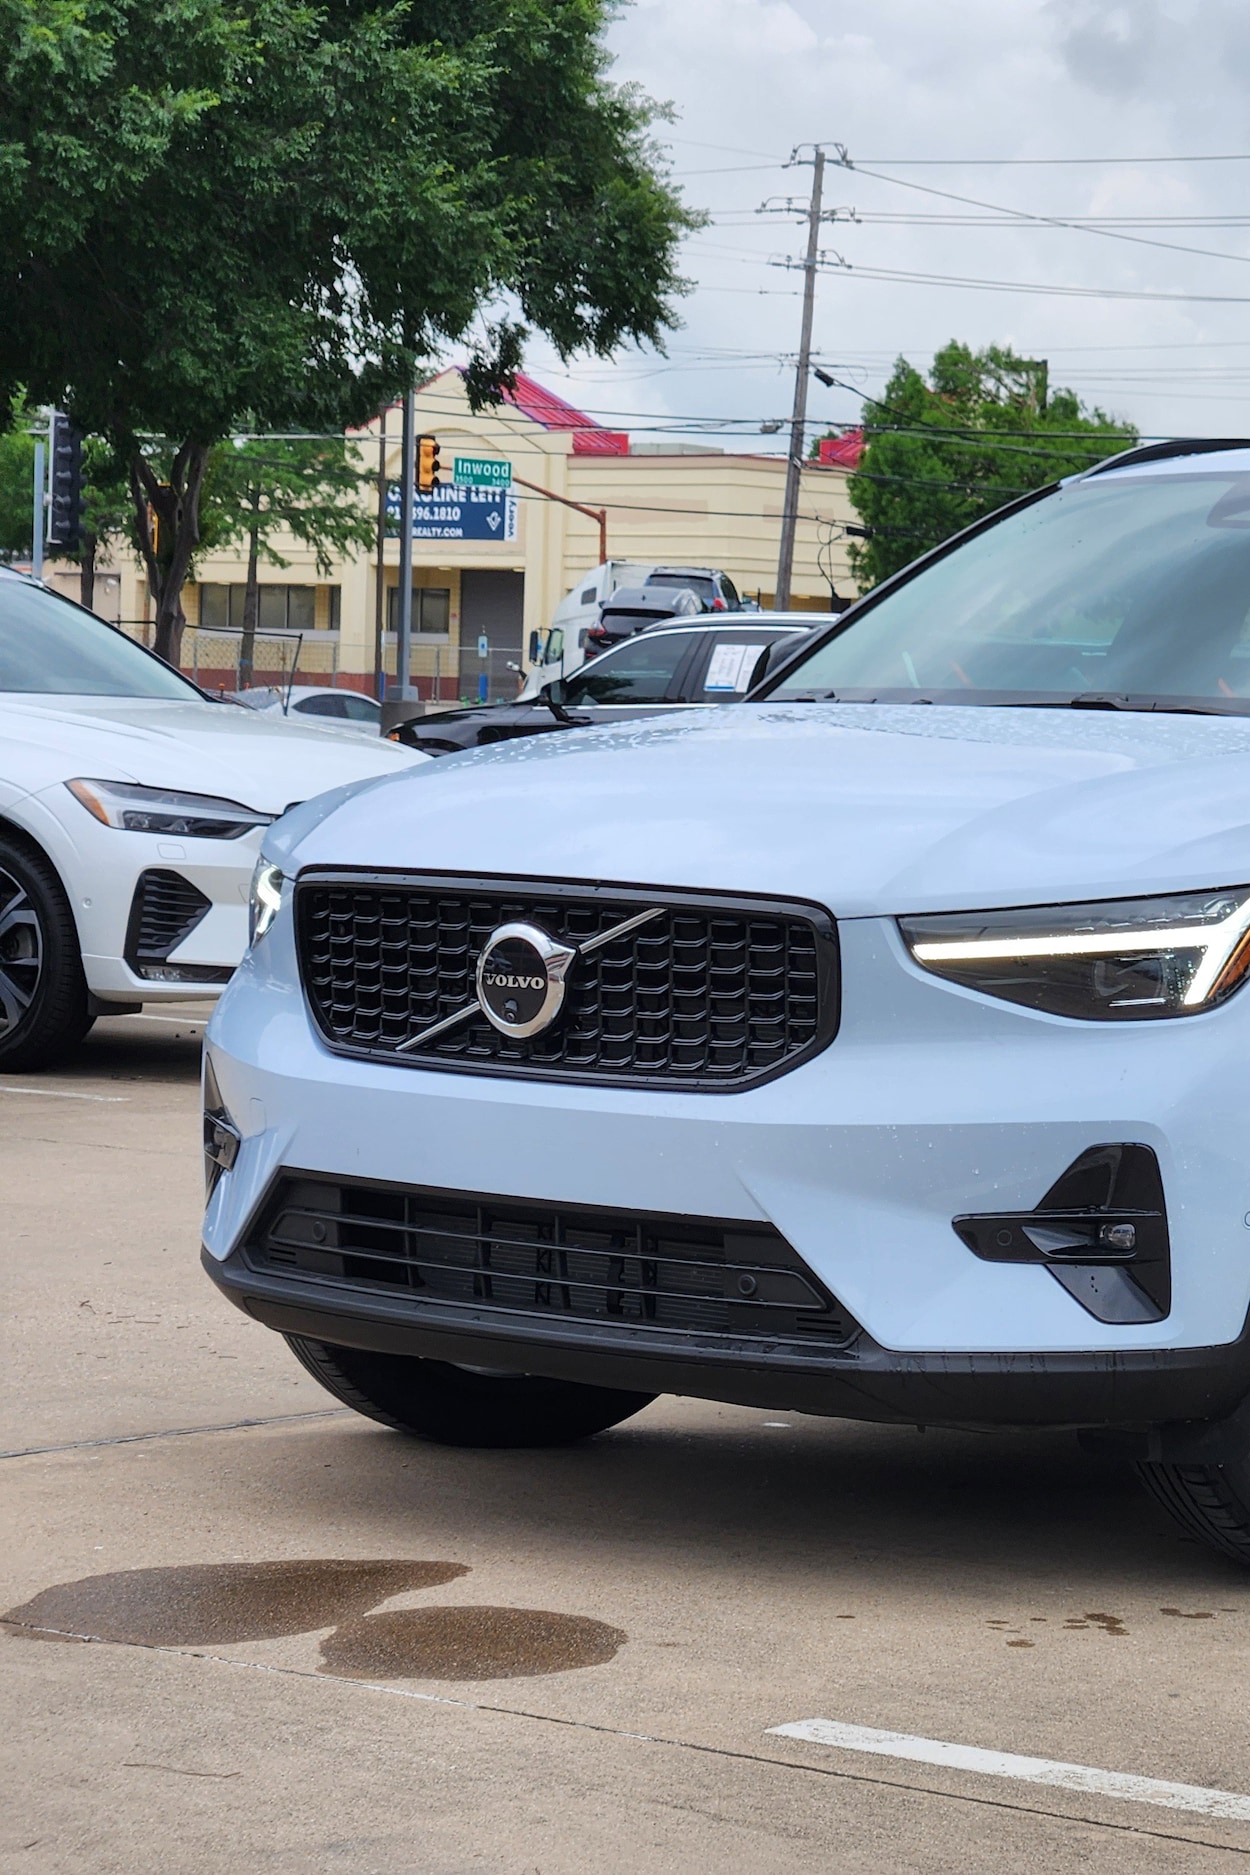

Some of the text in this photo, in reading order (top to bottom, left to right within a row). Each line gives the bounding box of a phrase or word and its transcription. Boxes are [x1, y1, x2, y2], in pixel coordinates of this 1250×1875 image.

[458, 460, 509, 477] Inwood
[387, 486, 466, 502] CLINE
[387, 506, 460, 521] 2196.1810
[483, 972, 545, 990] VOLVO
